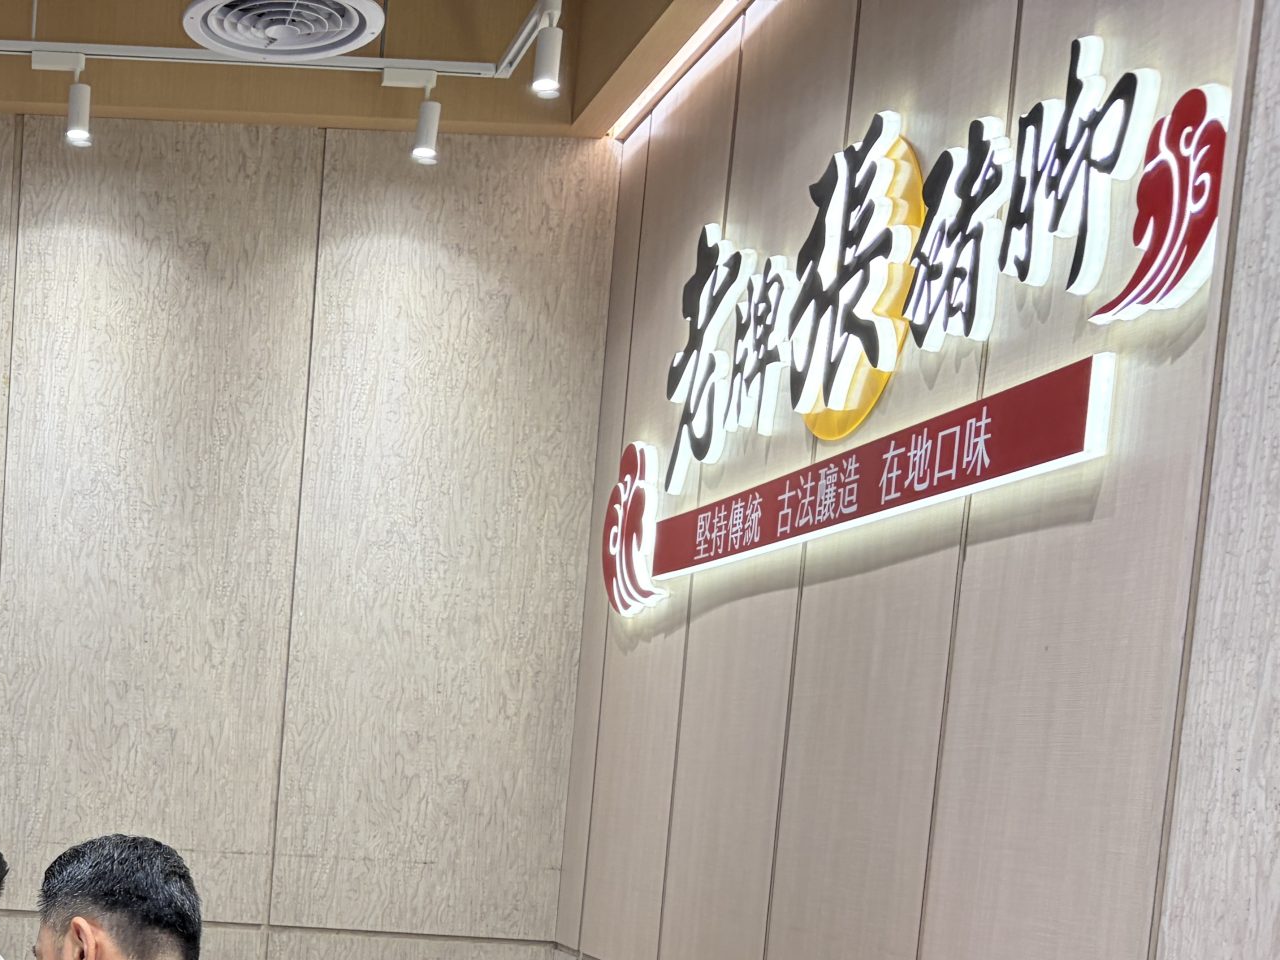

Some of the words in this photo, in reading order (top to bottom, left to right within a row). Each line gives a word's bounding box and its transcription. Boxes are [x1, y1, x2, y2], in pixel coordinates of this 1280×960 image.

[694, 492, 763, 560] 堅持傳統
[777, 454, 860, 537] 古法釀造
[878, 405, 992, 506] 在地口味
